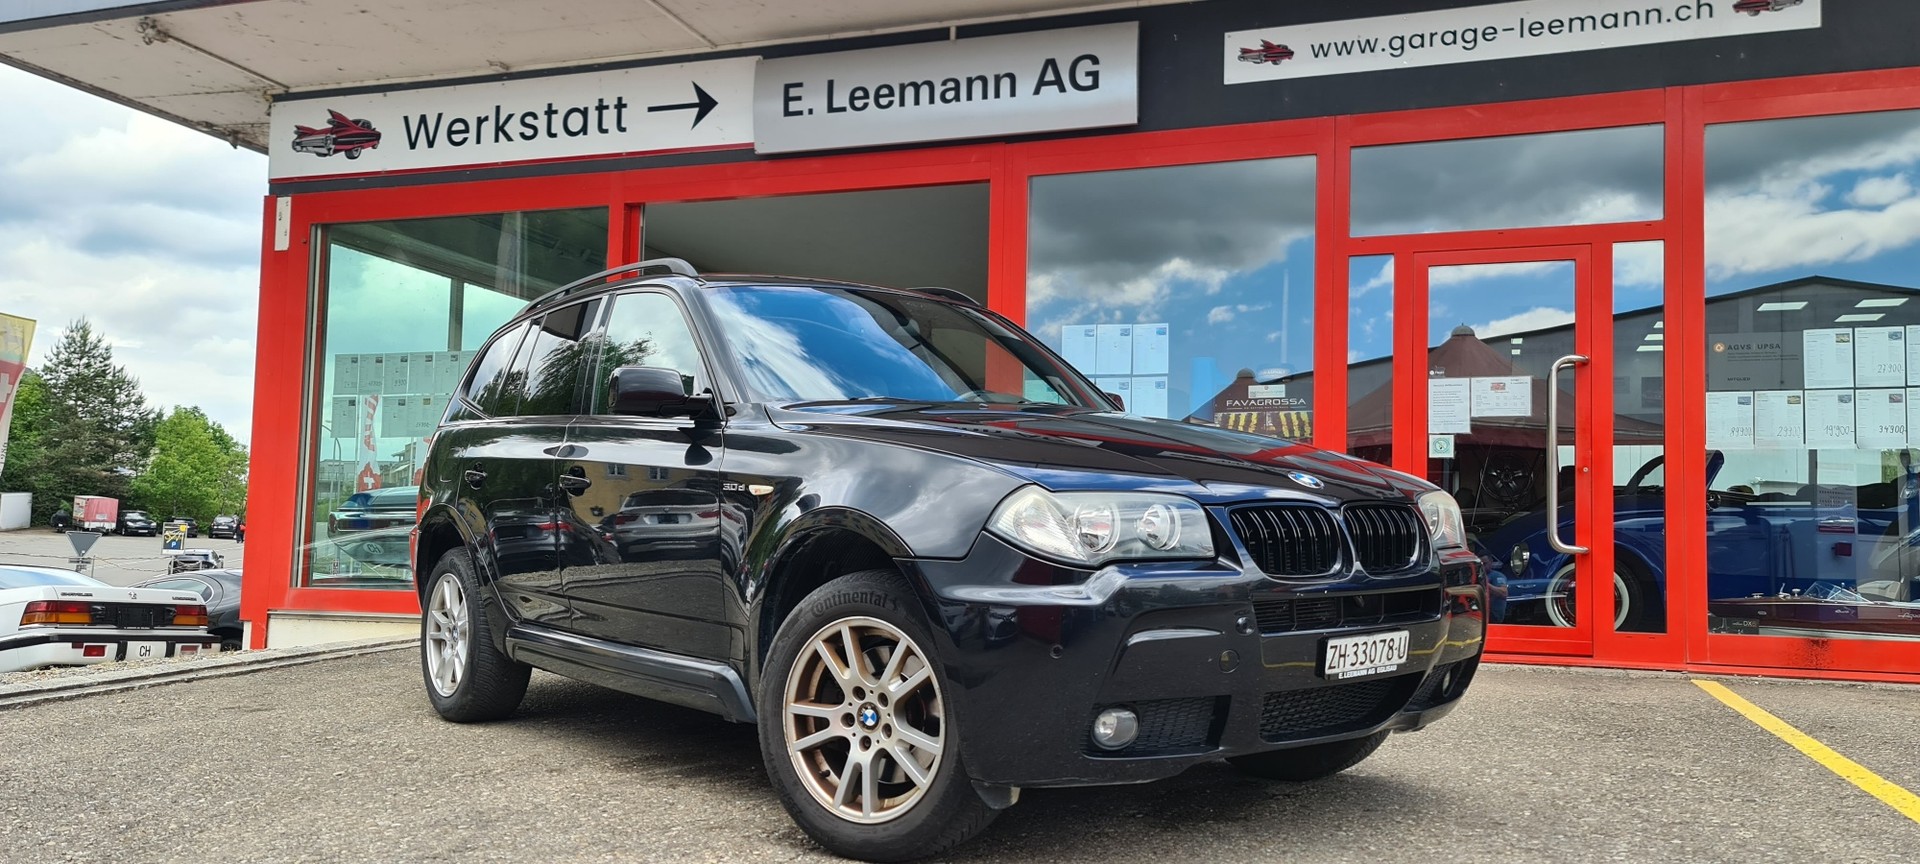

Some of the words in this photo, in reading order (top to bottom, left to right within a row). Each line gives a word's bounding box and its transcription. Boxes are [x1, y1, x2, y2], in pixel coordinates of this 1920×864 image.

[1310, 0, 1714, 58] www.garage-leemann.ch
[783, 82, 813, 117] E.
[827, 70, 1017, 113] Leemann
[1032, 54, 1101, 96] AG
[403, 96, 628, 150] Werkstatt
[1727, 343, 1752, 351] AGVS
[1226, 398, 1306, 407] FAVAGROSSA
[811, 589, 889, 618] Continental
[139, 645, 152, 657] CH
